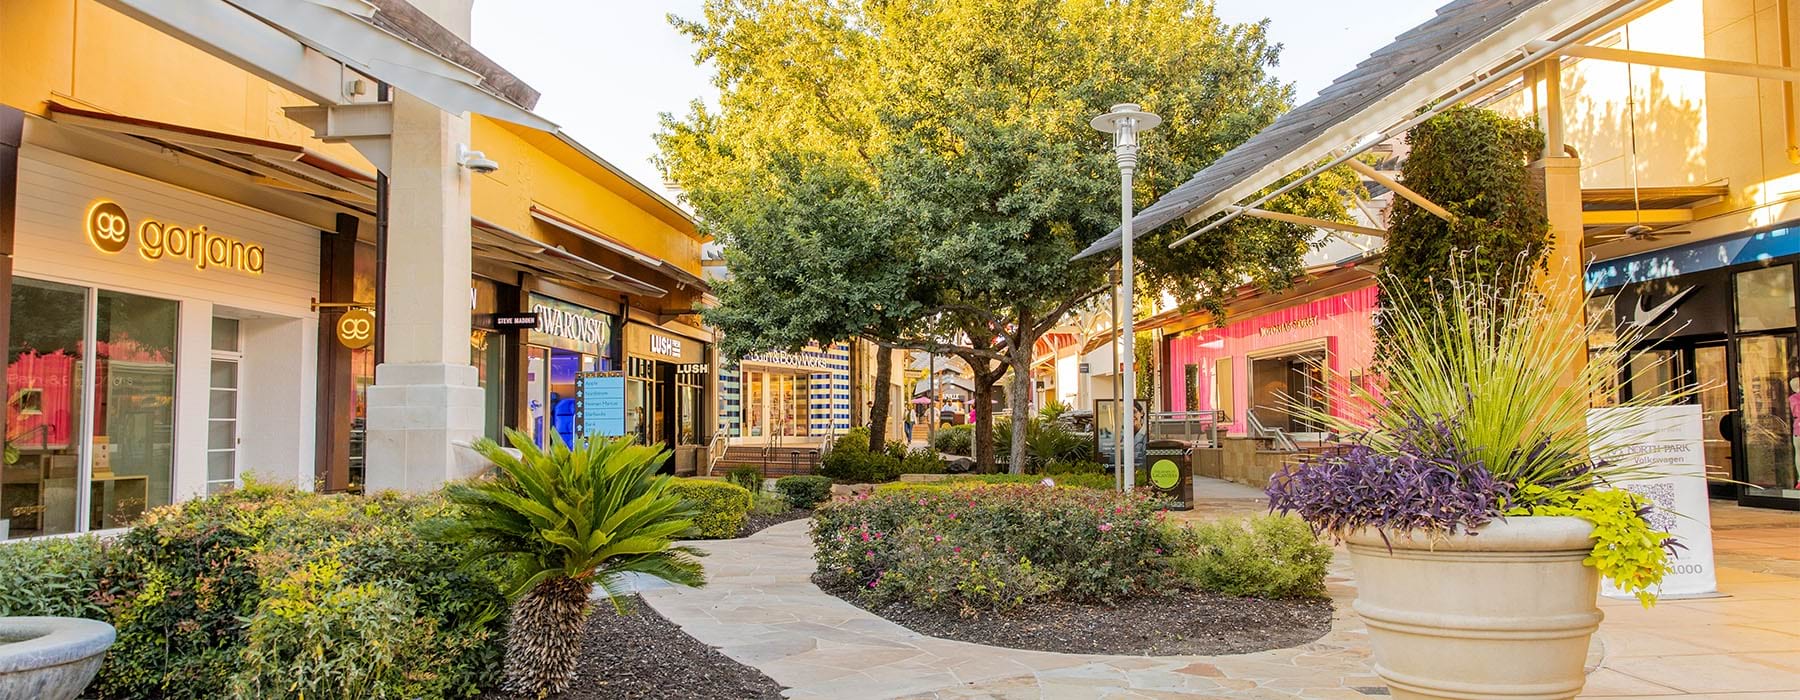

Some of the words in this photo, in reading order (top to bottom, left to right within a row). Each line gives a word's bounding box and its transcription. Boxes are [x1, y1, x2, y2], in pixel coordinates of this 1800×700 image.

[138, 216, 265, 274] gorjana
[498, 317, 512, 325] STEVE
[514, 317, 535, 325] MADDEN
[534, 303, 606, 345] SWAROVSKI
[651, 334, 672, 356] LUSH
[780, 351, 801, 368] Body
[677, 364, 708, 374] LUSH
[1628, 445, 1661, 454] NORTH
[1664, 444, 1691, 453] PARK
[1634, 456, 1684, 465] Volkswagen
